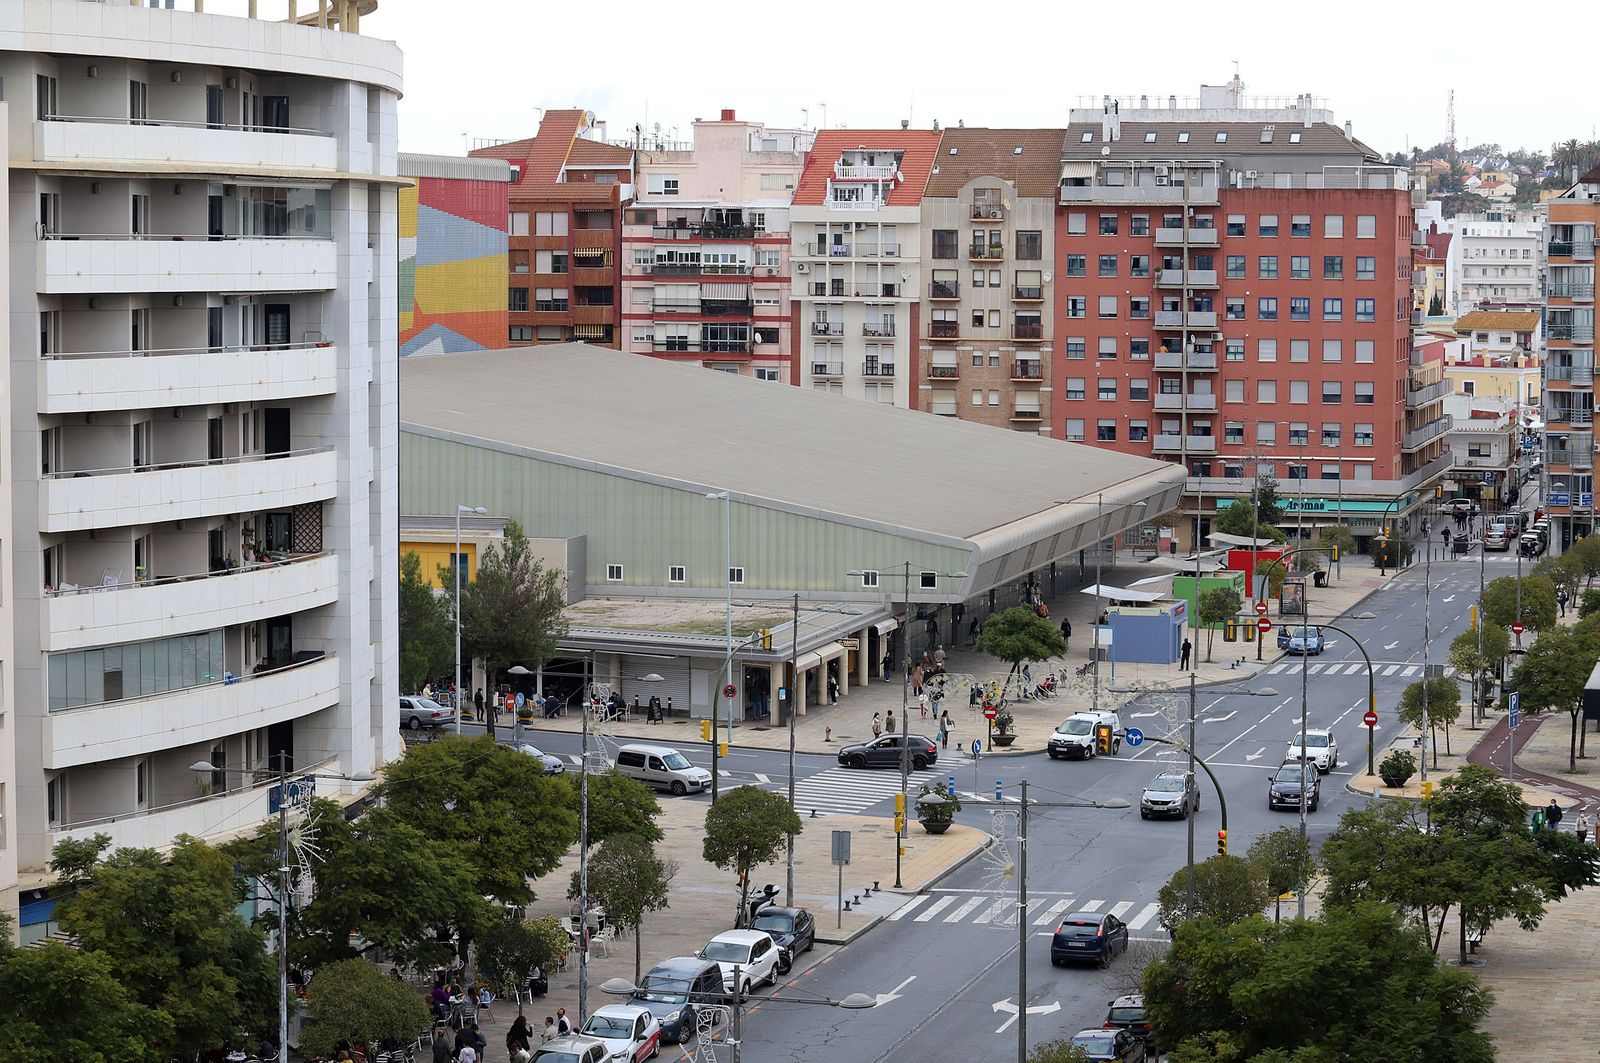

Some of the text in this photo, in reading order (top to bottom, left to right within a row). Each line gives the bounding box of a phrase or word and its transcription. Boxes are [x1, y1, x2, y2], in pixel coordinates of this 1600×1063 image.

[1485, 472, 1492, 480] P
[1284, 501, 1325, 510] Aromas
[1511, 695, 1517, 710] P
